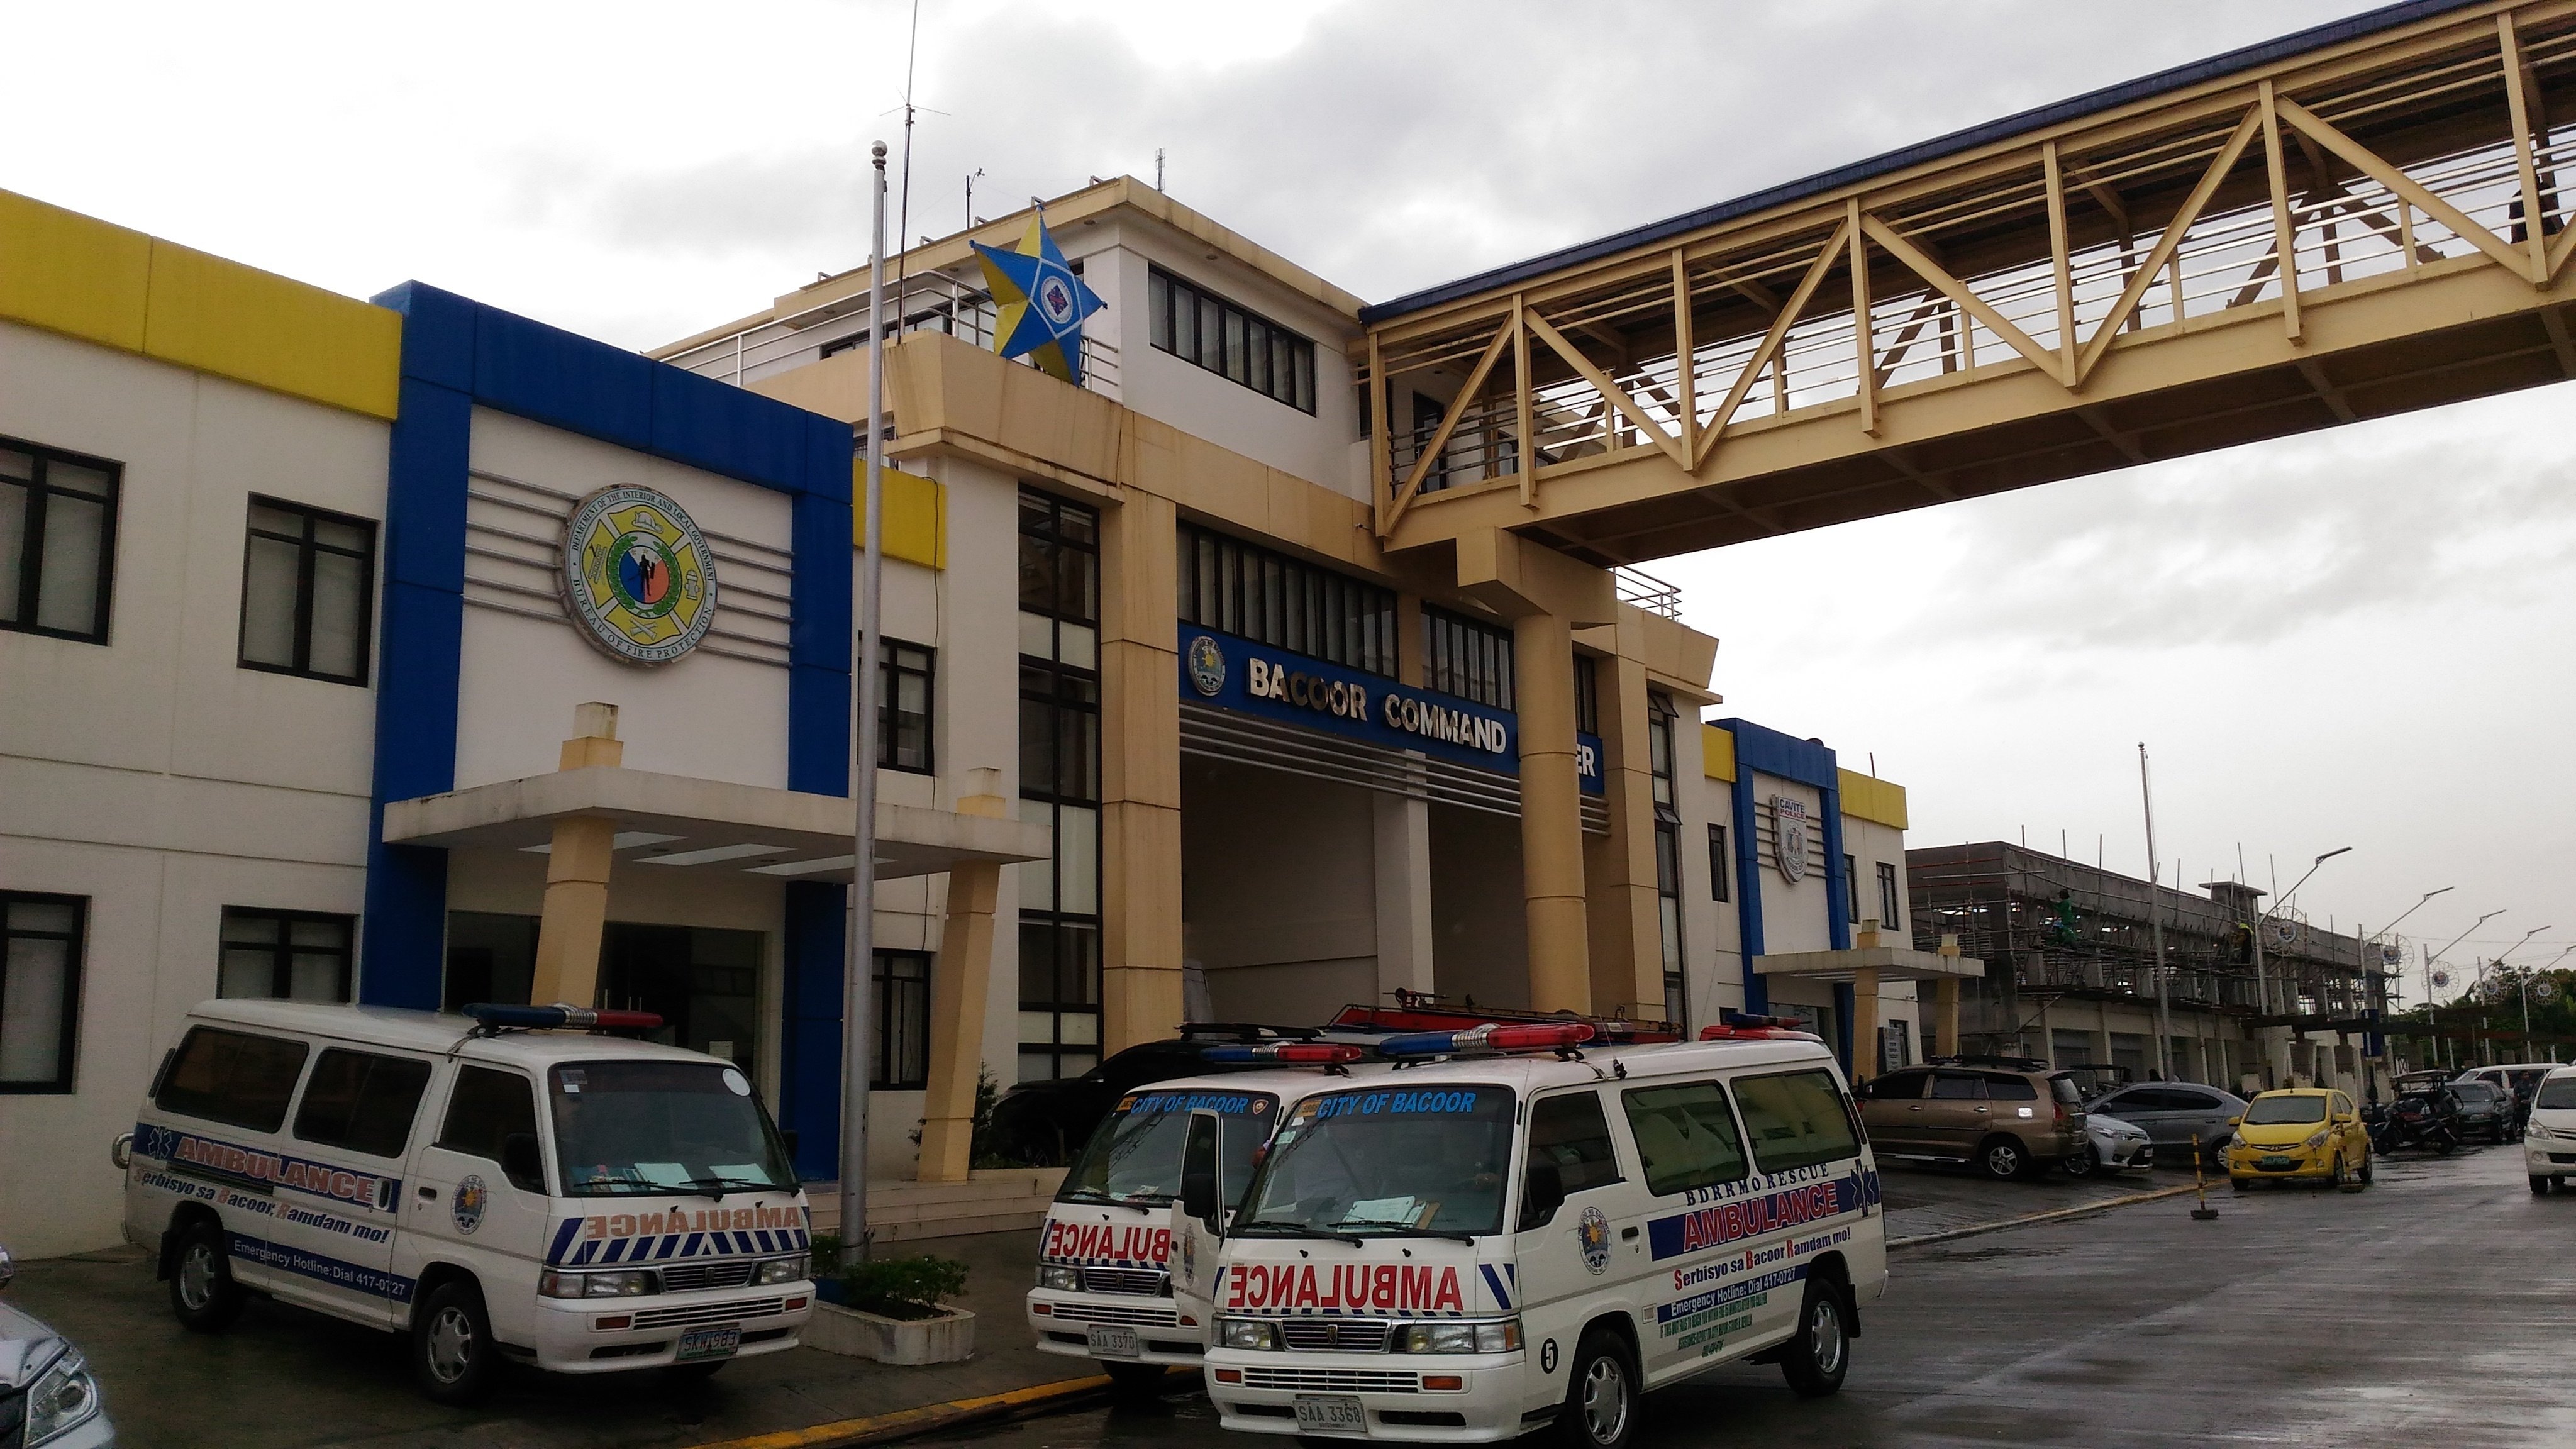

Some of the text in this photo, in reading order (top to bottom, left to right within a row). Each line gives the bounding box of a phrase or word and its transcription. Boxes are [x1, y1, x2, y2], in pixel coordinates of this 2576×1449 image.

[572, 491, 714, 581] DEPARTMENT OF THE INTERIOR AND LOCAL GOVERNMENT
[573, 579, 712, 658] BUREAU OF FIRE PROTECTION
[1249, 657, 1368, 721] BACOOR
[1384, 694, 1507, 754] COMMAND
[1780, 799, 1805, 814] CAVITE
[1780, 809, 1806, 820] POLICE
[1131, 1096, 1249, 1114] CITY OF BACOOR
[1317, 1091, 1477, 1119] CITY OF BACOOR
[174, 1136, 374, 1204] AMBULANCE
[1685, 1164, 1829, 1206] BDRRMO RESCUE
[134, 1167, 195, 1195] Serbisyo
[196, 1186, 216, 1200] sa
[275, 1203, 352, 1234] Ramdam
[353, 1224, 390, 1243] mo!
[1684, 1181, 1840, 1252] AMBULANCE
[234, 1240, 291, 1267] Emergency
[356, 1273, 405, 1296] 417-0727
[1674, 1227, 1851, 1291] Serbisyo sa Bacoor Ramdam mo!
[1671, 1293, 1715, 1316] Emergency
[1717, 1285, 1747, 1302] Hotline:
[1748, 1278, 1762, 1291] Dial
[1764, 1268, 1796, 1288] 417-0727
[714, 1331, 736, 1348] 983
[1091, 1334, 1135, 1348] SAA 3370
[1546, 1342, 1554, 1369] 5
[1299, 1406, 1360, 1423] SAA 3368
